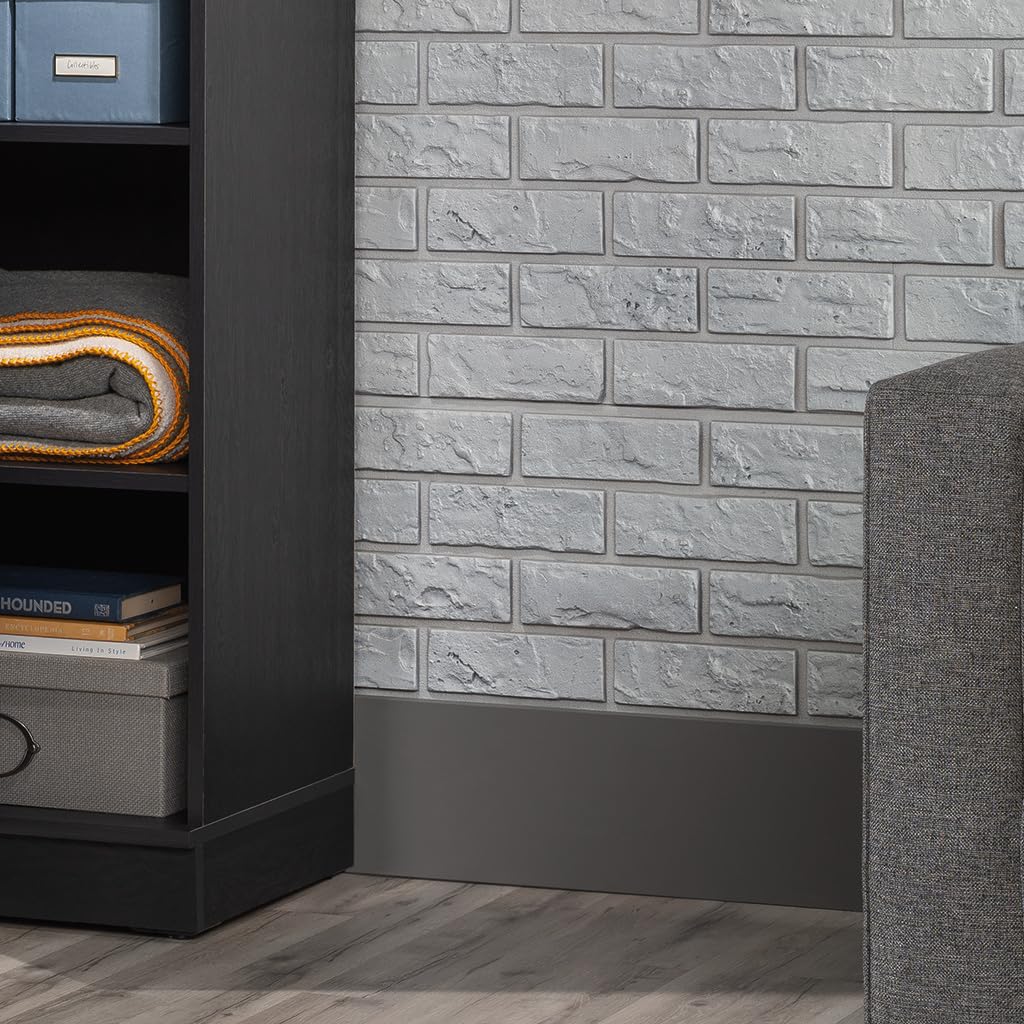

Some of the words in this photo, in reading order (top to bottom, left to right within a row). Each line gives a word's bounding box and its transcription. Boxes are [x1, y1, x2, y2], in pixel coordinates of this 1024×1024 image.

[0, 596, 72, 615] HOUNDED
[71, 645, 93, 654] Living
[108, 647, 126, 655] Style
